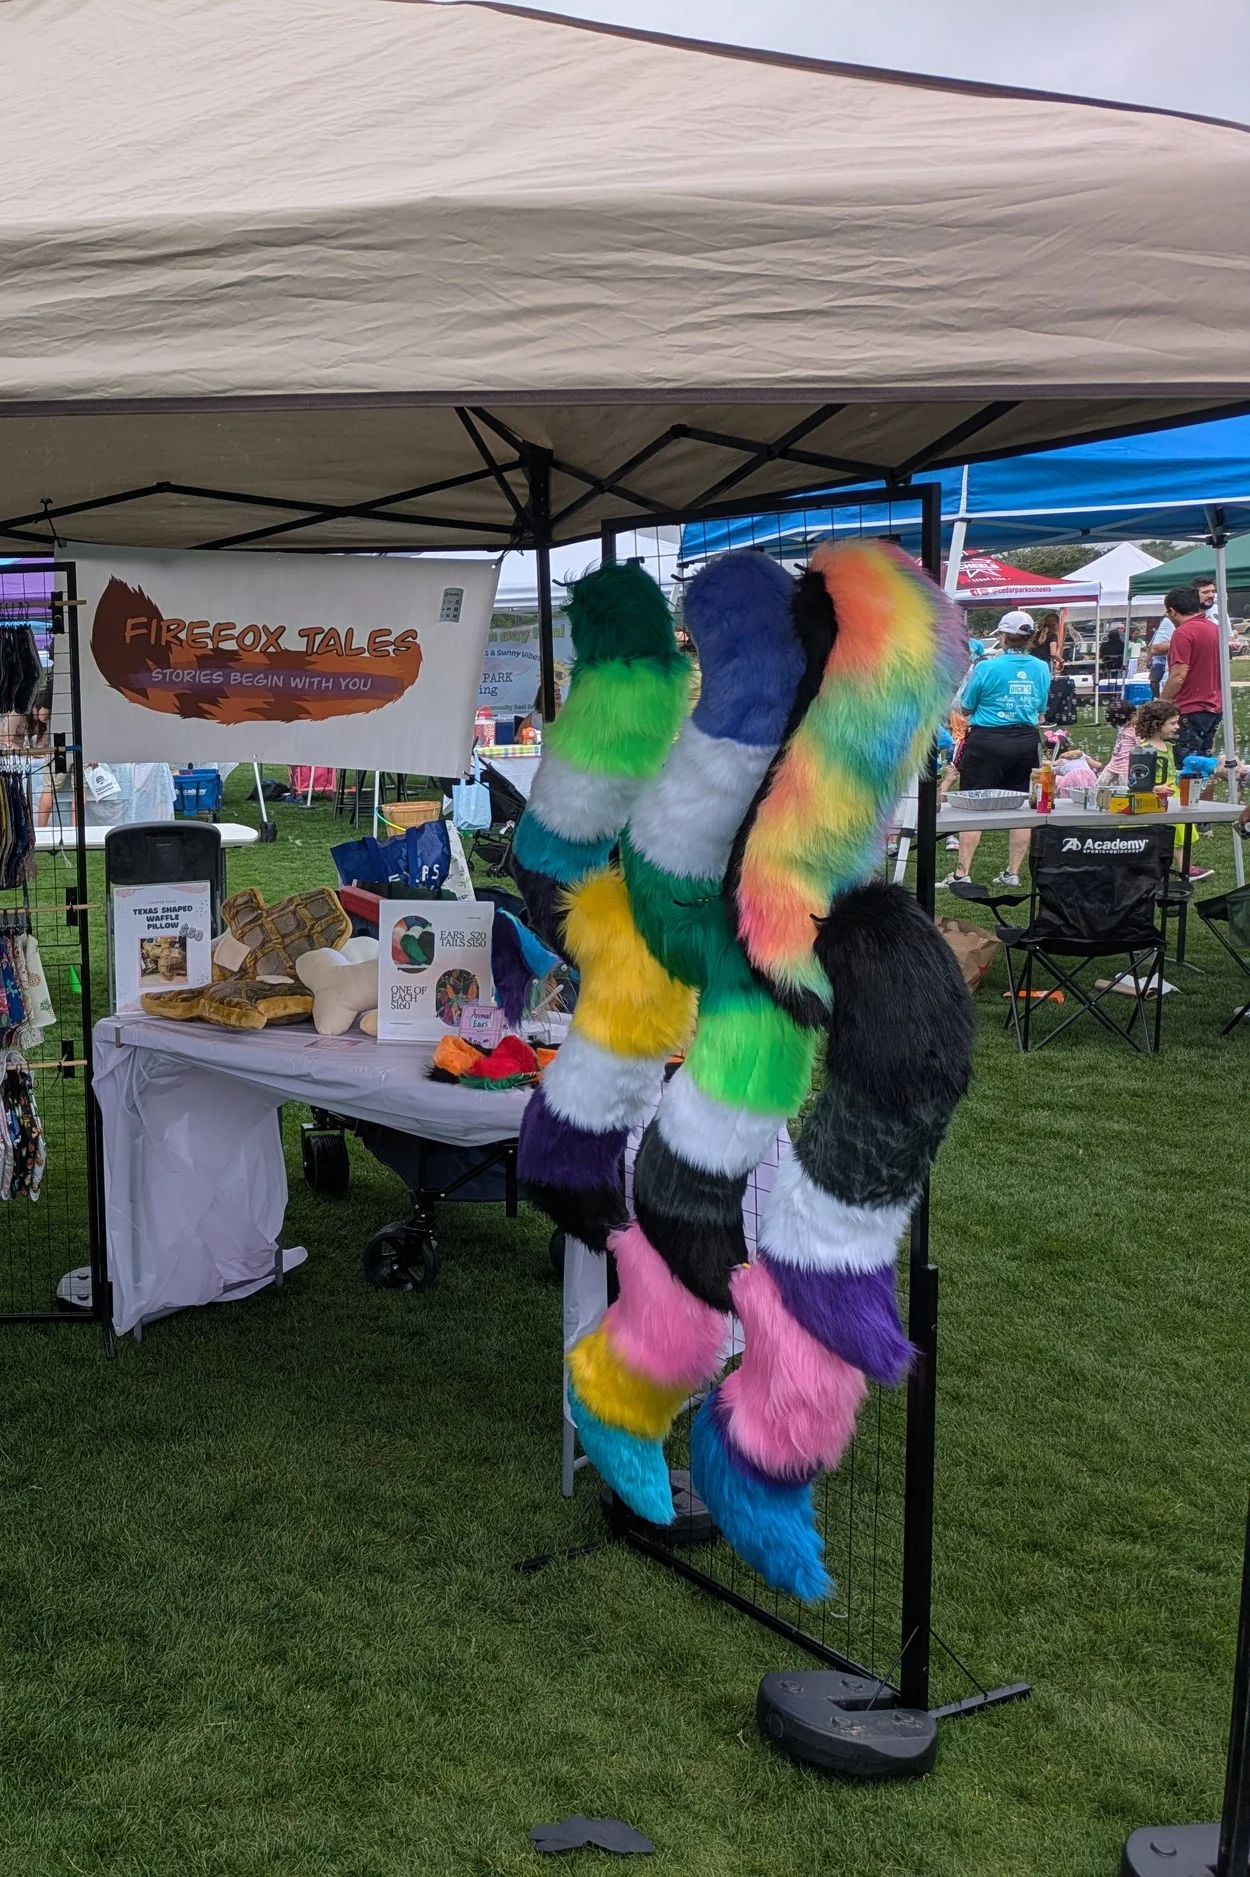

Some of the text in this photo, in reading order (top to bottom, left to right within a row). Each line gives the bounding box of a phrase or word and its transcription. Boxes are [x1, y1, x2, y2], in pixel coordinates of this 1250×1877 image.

[992, 586, 1052, 596] @cedarparkscheels
[125, 616, 418, 658] FIREFOX TALES
[497, 649, 521, 658] Sunny
[151, 668, 372, 692] STORIES BEGIN WITH YOU
[482, 672, 514, 683] PARK
[1083, 837, 1147, 852] Academy
[133, 905, 193, 916] TEXAS SHAPED
[146, 914, 180, 922] WAFFLE
[147, 922, 179, 930] PILLOW
[179, 922, 204, 941] $50
[440, 931, 487, 940] EARS $20
[441, 939, 487, 948] TAILS $150
[390, 985, 427, 995] ONE OF
[391, 994, 417, 1002] EACH
[390, 1002, 411, 1010] $160
[470, 1008, 492, 1020] Animal
[472, 1020, 489, 1029] Ears
